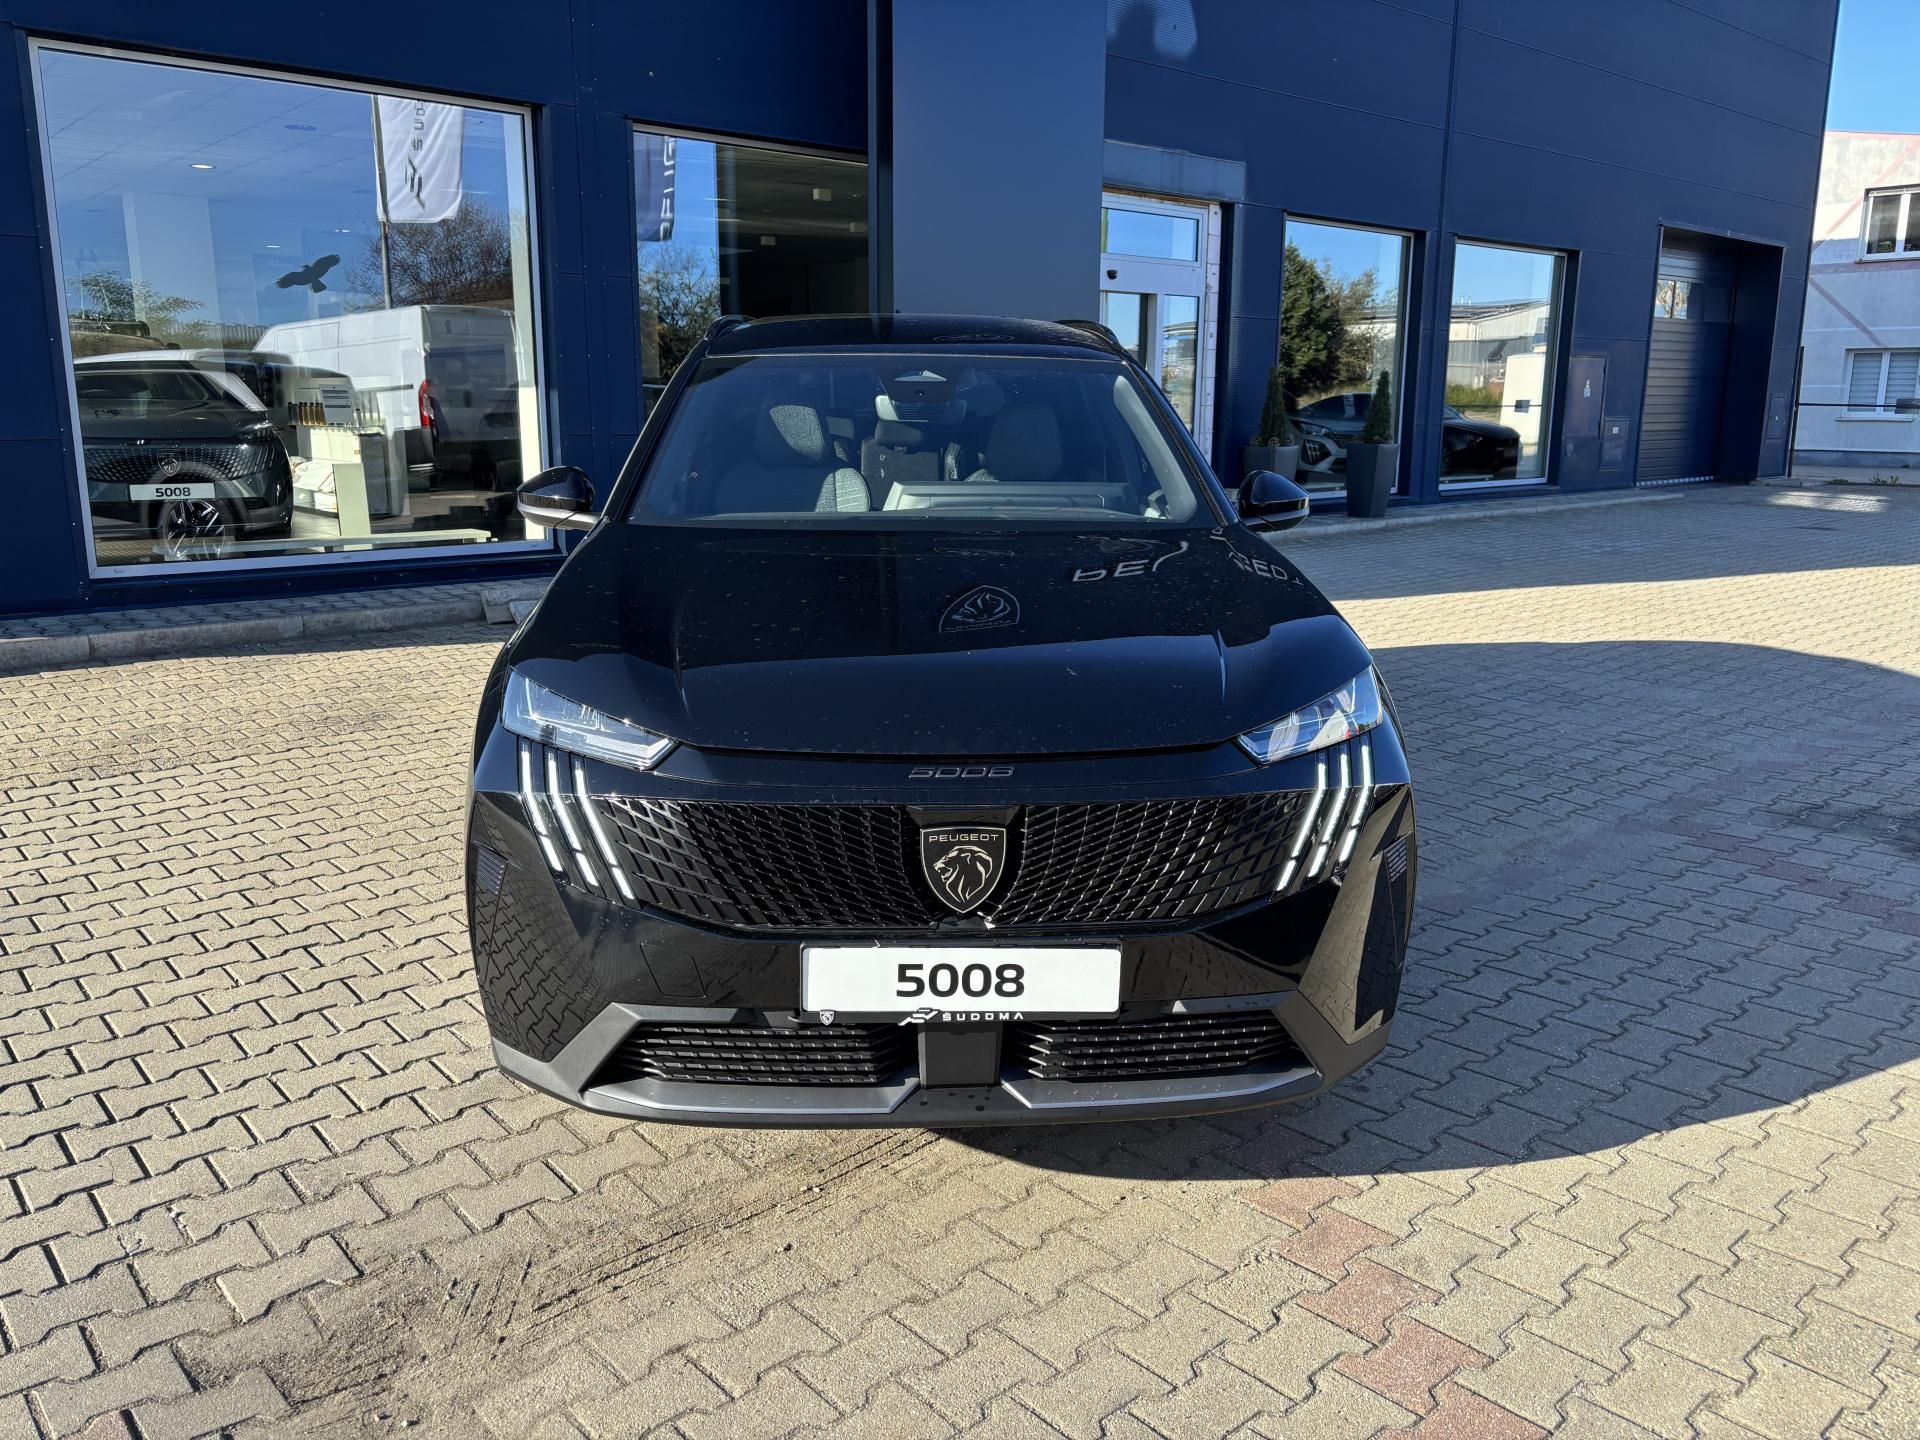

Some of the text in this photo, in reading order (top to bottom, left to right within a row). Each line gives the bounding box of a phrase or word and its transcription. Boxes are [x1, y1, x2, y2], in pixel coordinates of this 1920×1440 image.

[155, 487, 191, 498] 5008
[908, 766, 1016, 778] 5008
[928, 833, 999, 843] PEUGEOT
[896, 963, 1025, 998] 5008
